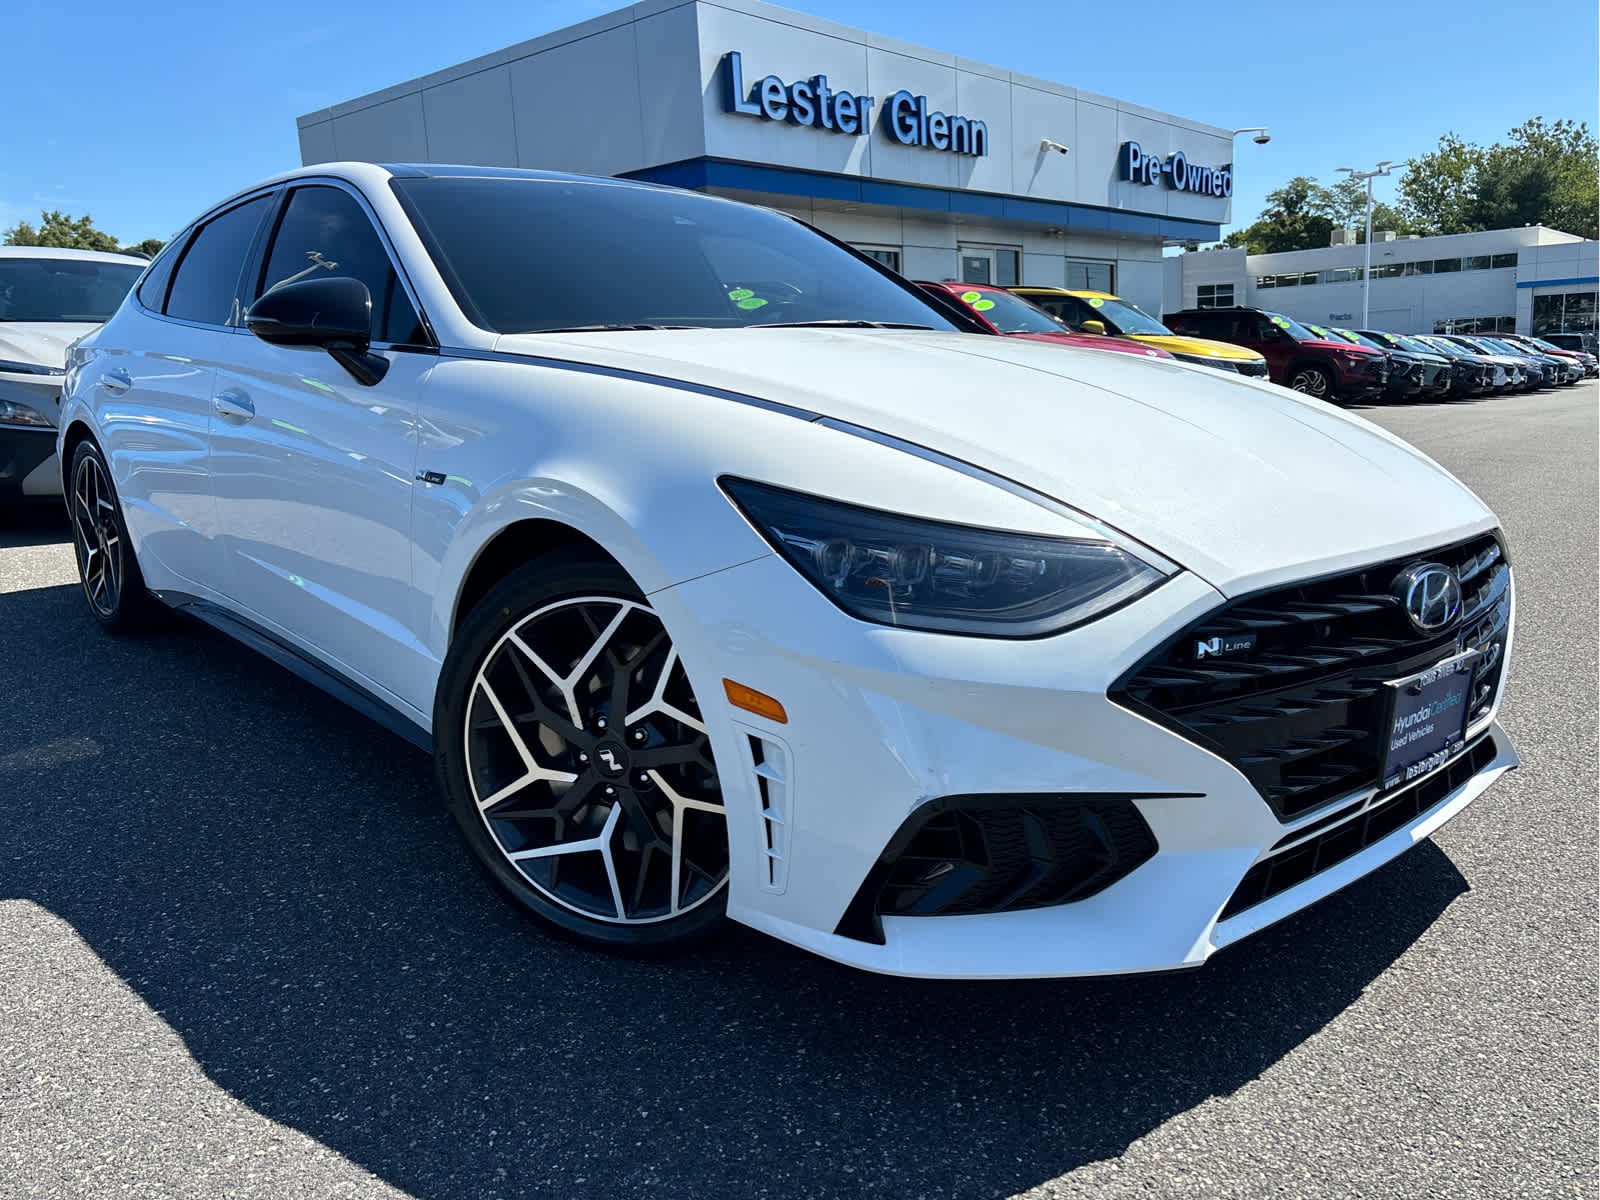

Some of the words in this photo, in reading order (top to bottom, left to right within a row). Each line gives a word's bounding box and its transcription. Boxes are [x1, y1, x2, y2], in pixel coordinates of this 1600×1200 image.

[720, 51, 874, 136] Lester
[880, 89, 988, 157] Glenn
[1120, 141, 1232, 198] Pre-Owned
[1390, 734, 1408, 751] Used
